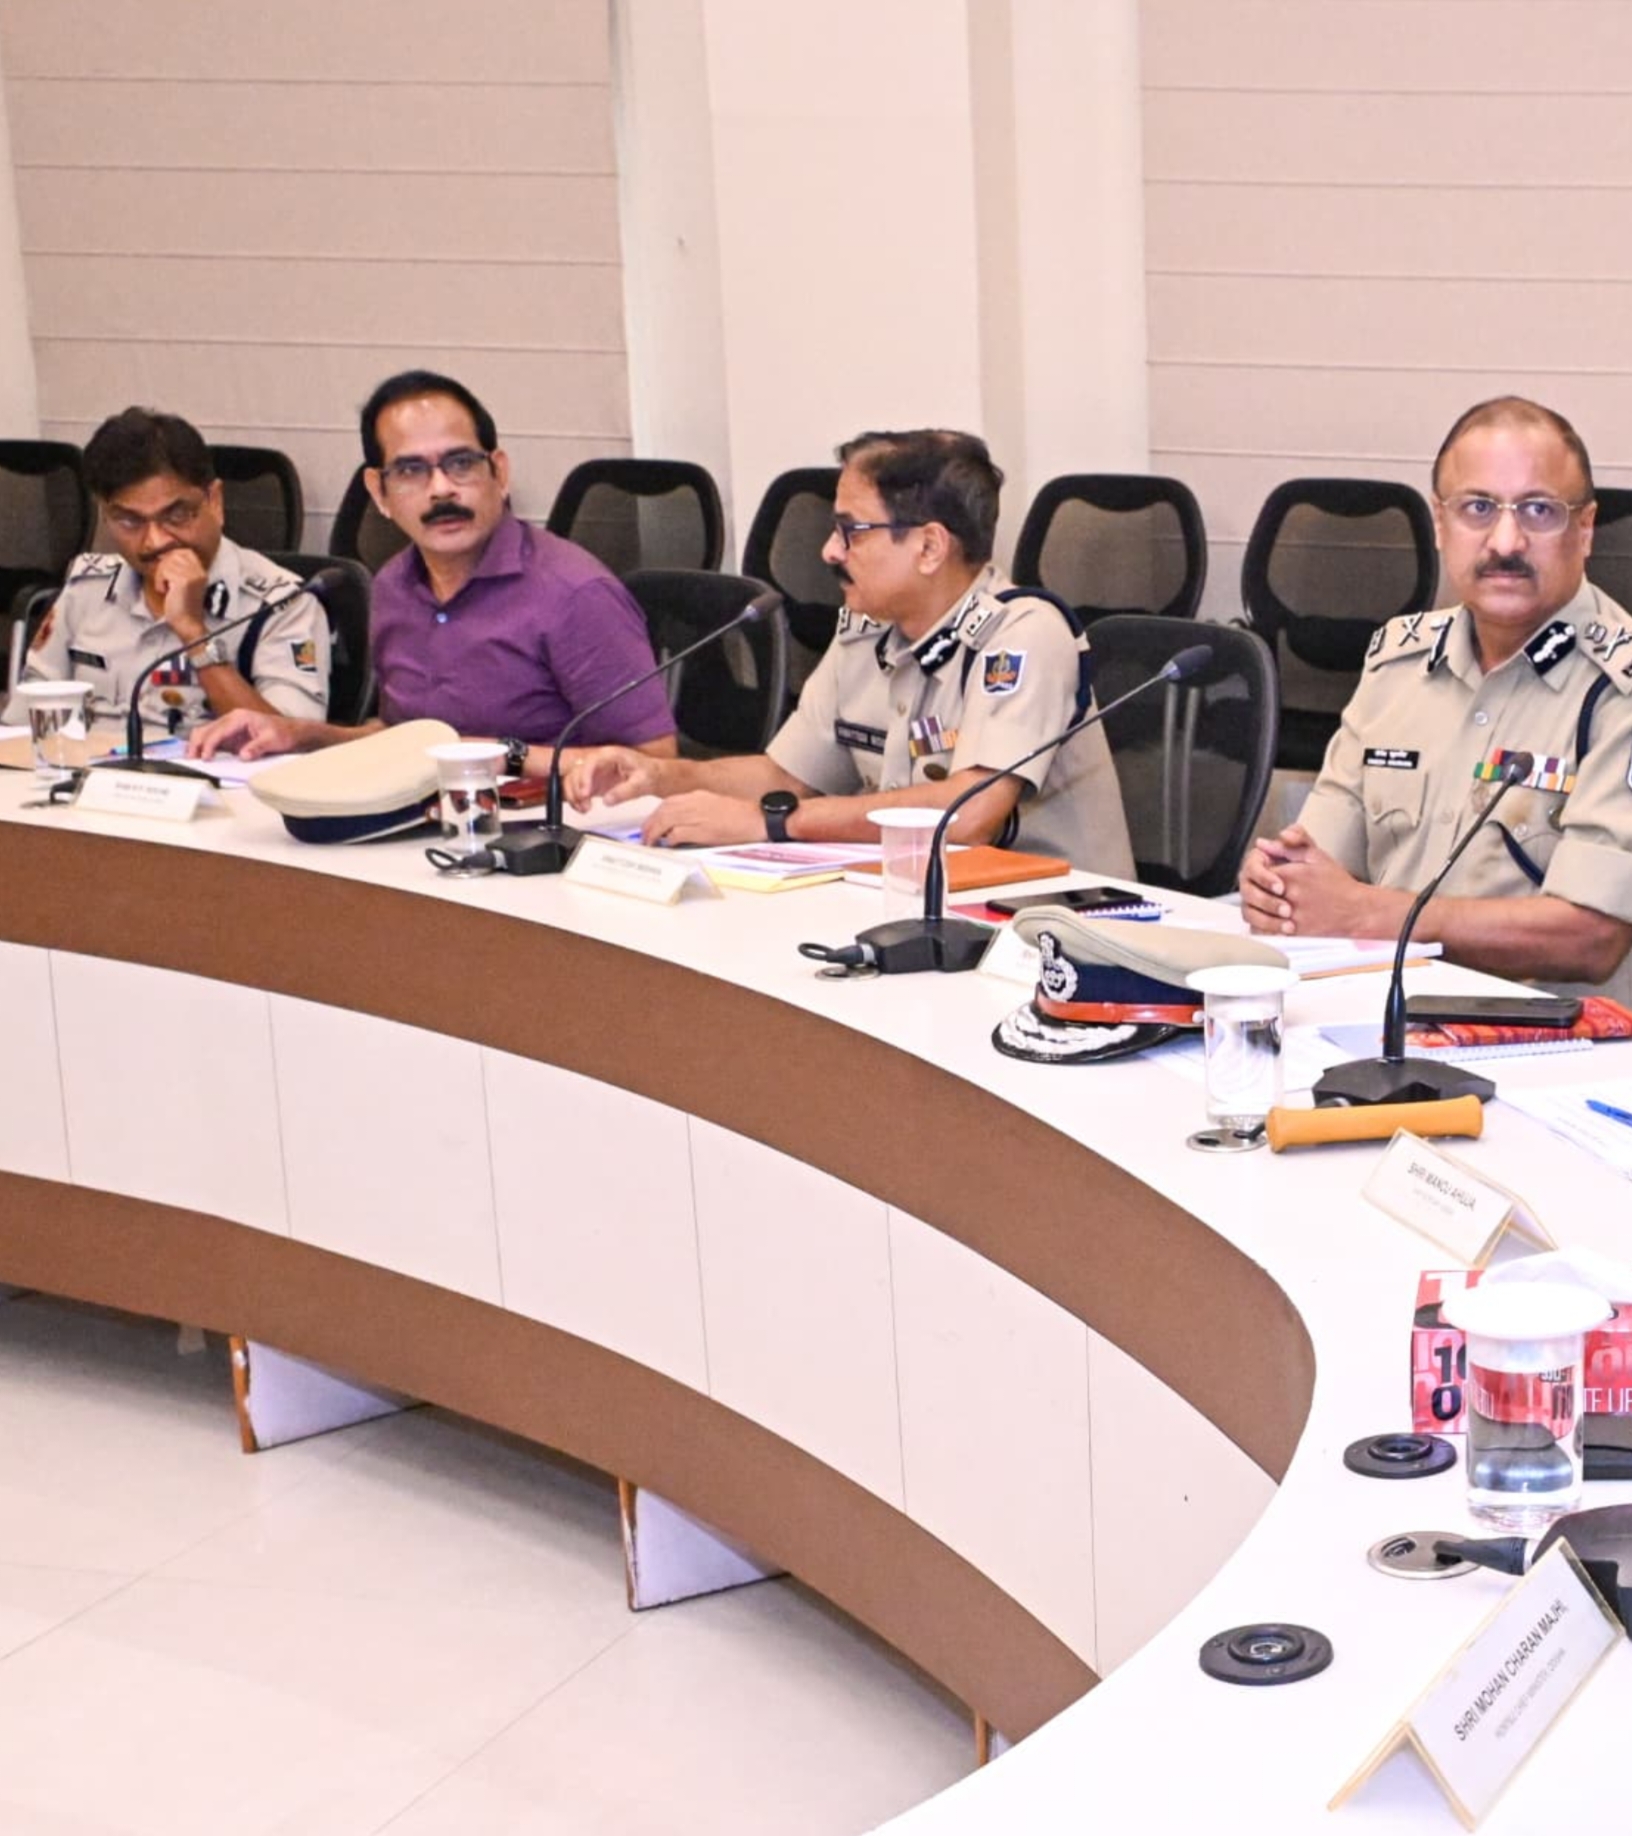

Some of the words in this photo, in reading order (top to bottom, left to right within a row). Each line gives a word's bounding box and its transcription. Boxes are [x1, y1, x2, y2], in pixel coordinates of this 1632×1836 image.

[1454, 1706, 1481, 1741] SHRI
[1474, 1670, 1509, 1714] MOHAN
[1505, 1627, 1542, 1677] CHARAN
